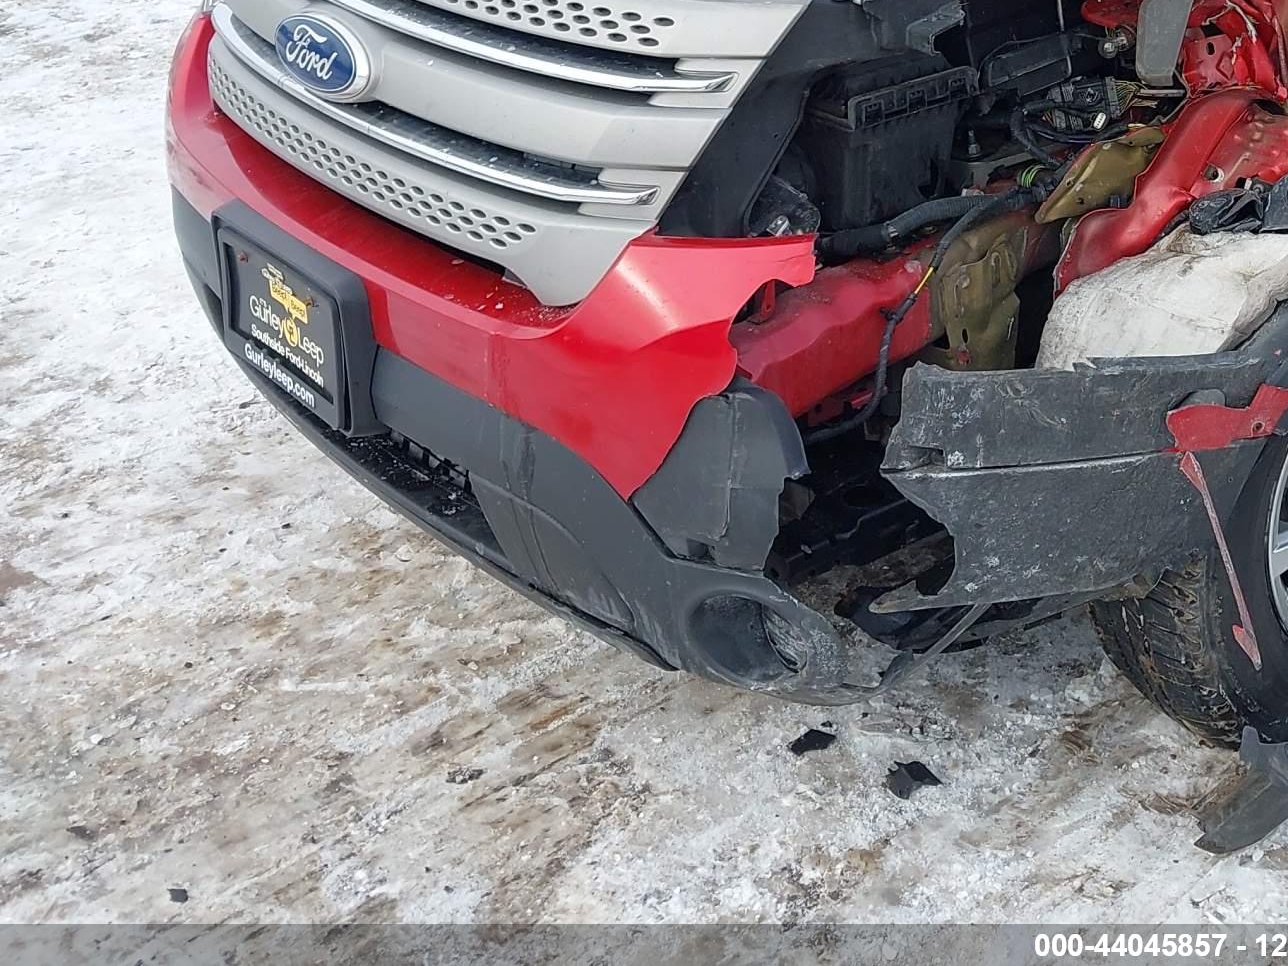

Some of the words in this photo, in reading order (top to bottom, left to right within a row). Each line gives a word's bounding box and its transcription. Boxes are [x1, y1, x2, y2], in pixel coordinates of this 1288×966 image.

[285, 24, 338, 81] Ford
[249, 295, 285, 338] Gurley
[297, 326, 324, 368] Leep
[250, 323, 285, 356] Southside
[285, 346, 324, 389] Ford-Lincoln
[244, 342, 315, 408] Gurleyleep.com
